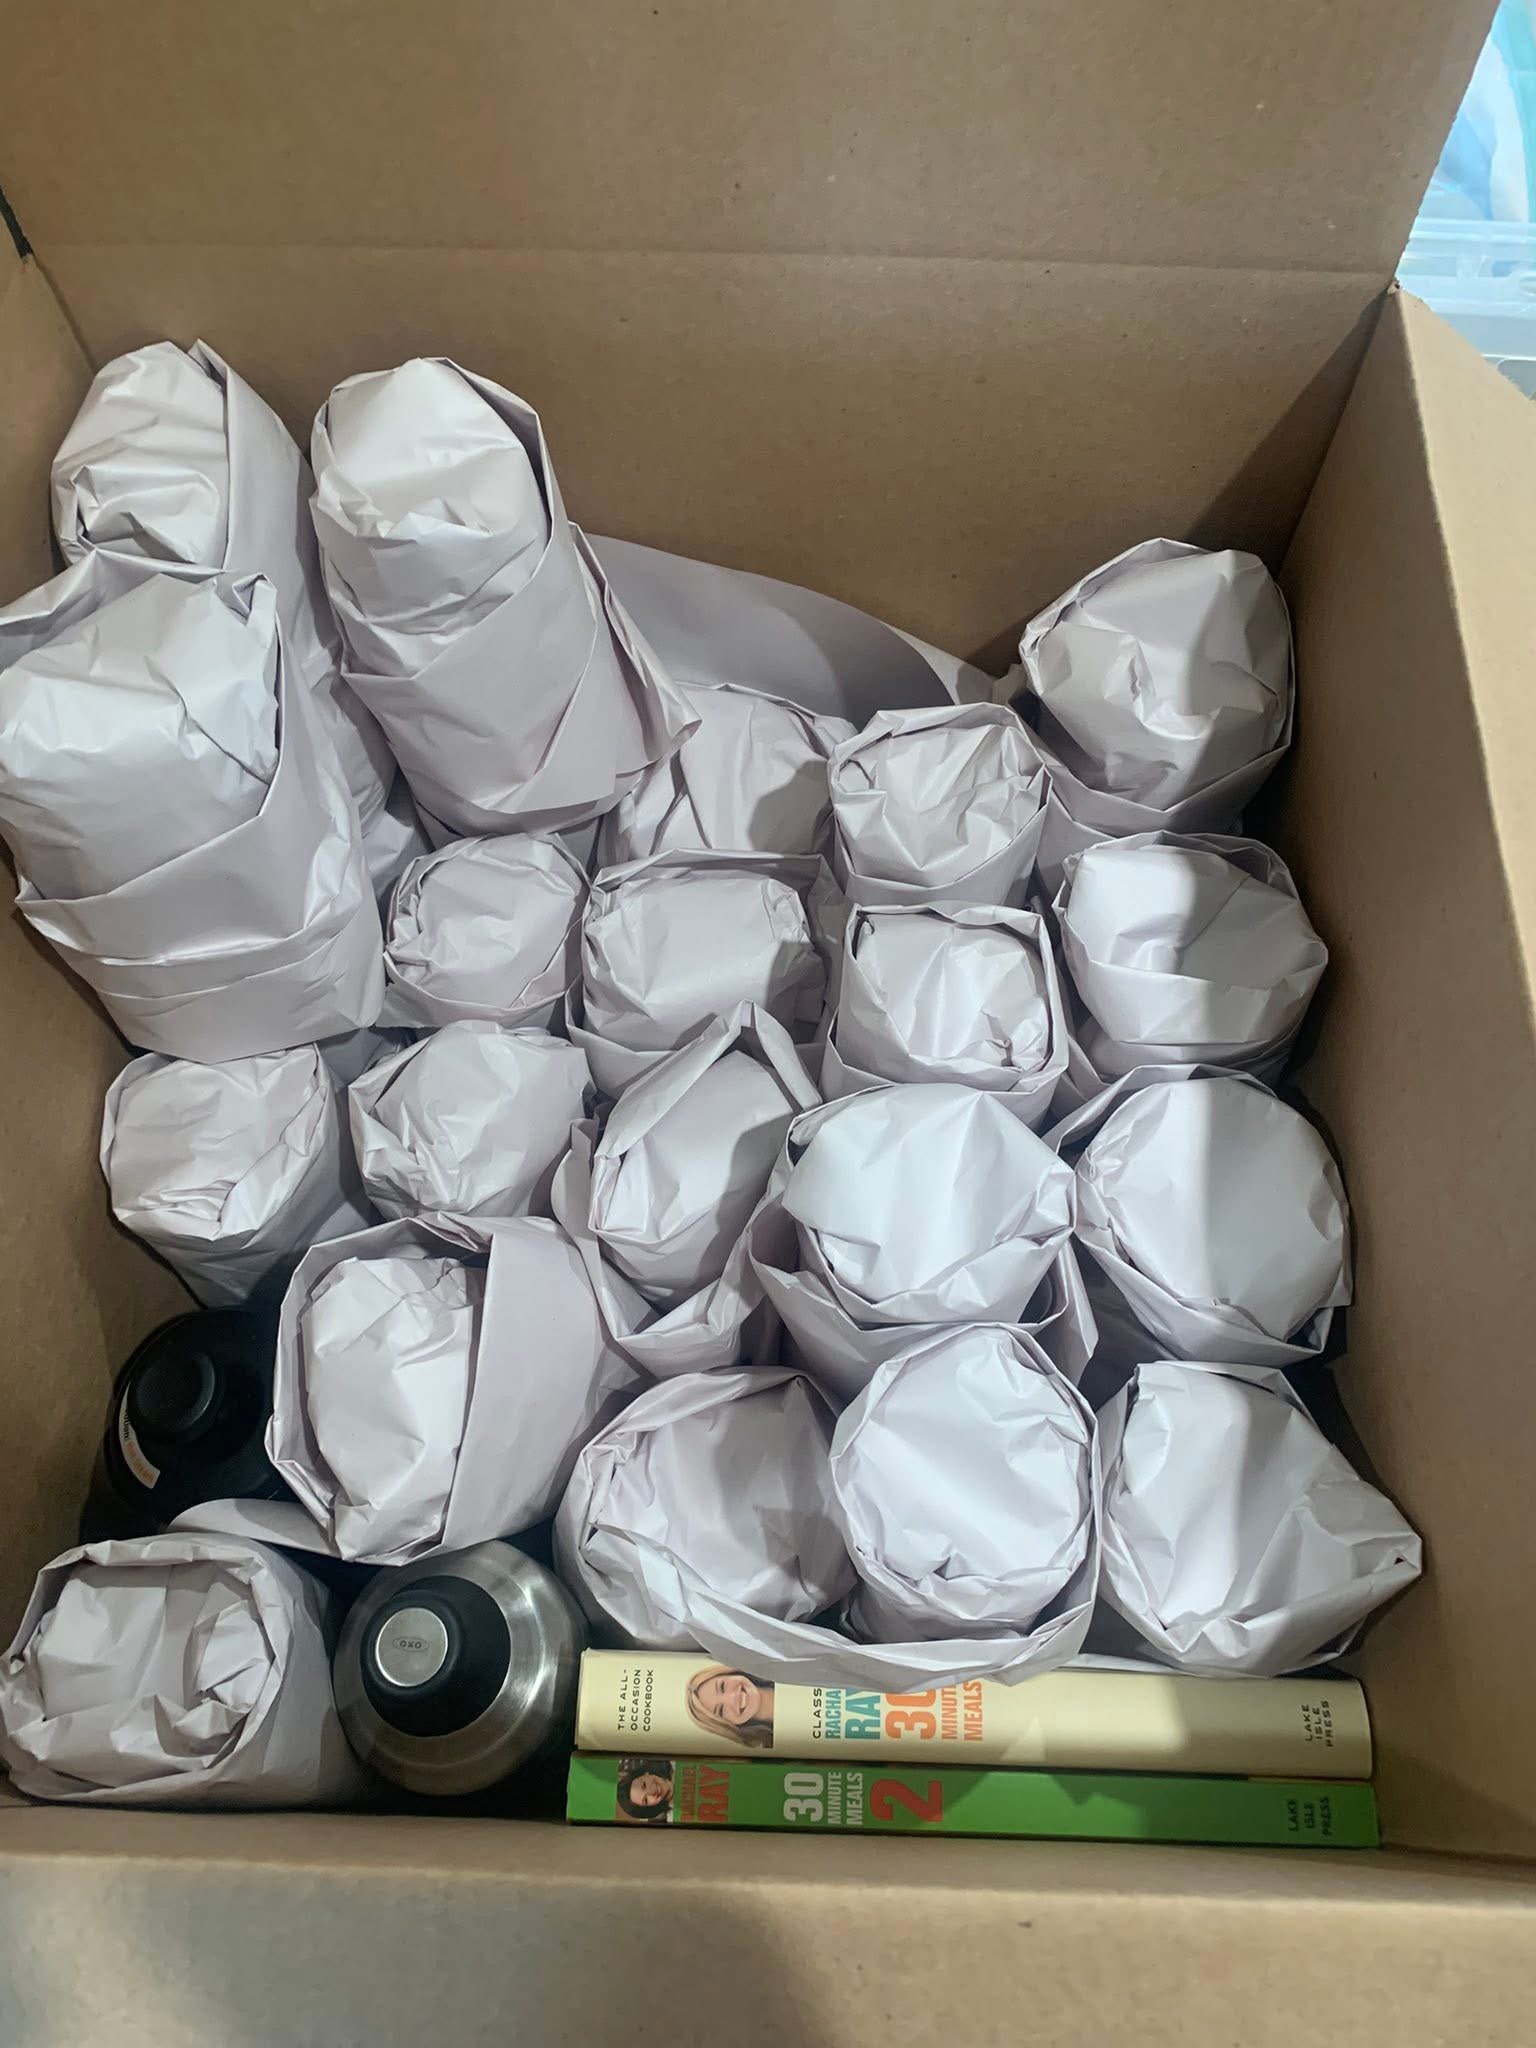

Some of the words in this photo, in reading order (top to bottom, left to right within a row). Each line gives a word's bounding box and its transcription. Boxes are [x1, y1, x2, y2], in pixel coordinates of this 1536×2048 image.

[620, 1669, 629, 1701] ALL-
[630, 1669, 641, 1732] OCCASION
[643, 1669, 654, 1732] COOKBOOK
[963, 1680, 983, 1741] MEALS
[617, 1706, 627, 1731] THE
[812, 1687, 823, 1739] CLASS
[825, 1688, 842, 1740] RACHA
[1301, 1704, 1313, 1742] LAKE
[1312, 1706, 1323, 1740] ISLE
[1320, 1700, 1334, 1747] PRESS
[698, 1764, 730, 1822] RAY
[783, 1772, 824, 1822] 30
[827, 1771, 842, 1825] MINUTE
[846, 1772, 863, 1825] MEALS
[869, 1778, 943, 1823] 2
